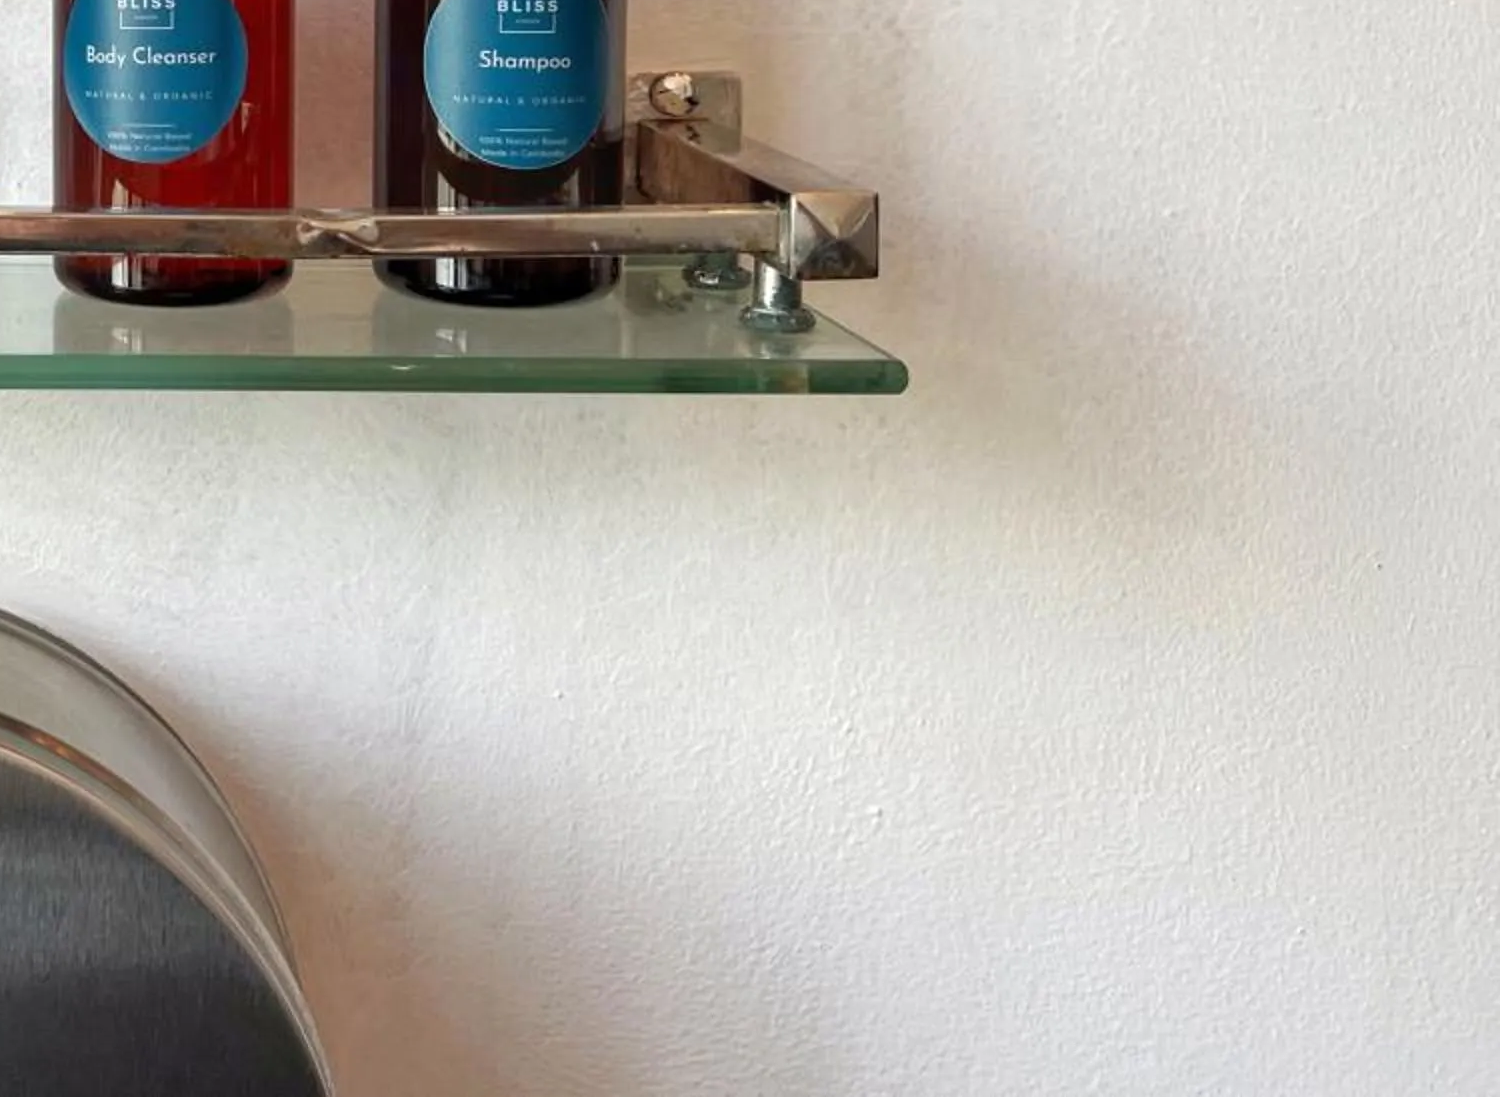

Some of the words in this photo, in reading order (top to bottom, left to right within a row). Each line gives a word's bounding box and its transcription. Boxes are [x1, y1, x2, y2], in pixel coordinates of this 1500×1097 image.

[497, 0, 559, 13] BLISS
[86, 45, 127, 69] Body
[133, 46, 216, 64] Cleanser
[479, 49, 572, 73] Shampoo
[85, 90, 134, 101] NATURAL
[153, 90, 214, 101] ORGANIC
[452, 94, 510, 105] NATURAL
[532, 95, 586, 106] ORGANIC
